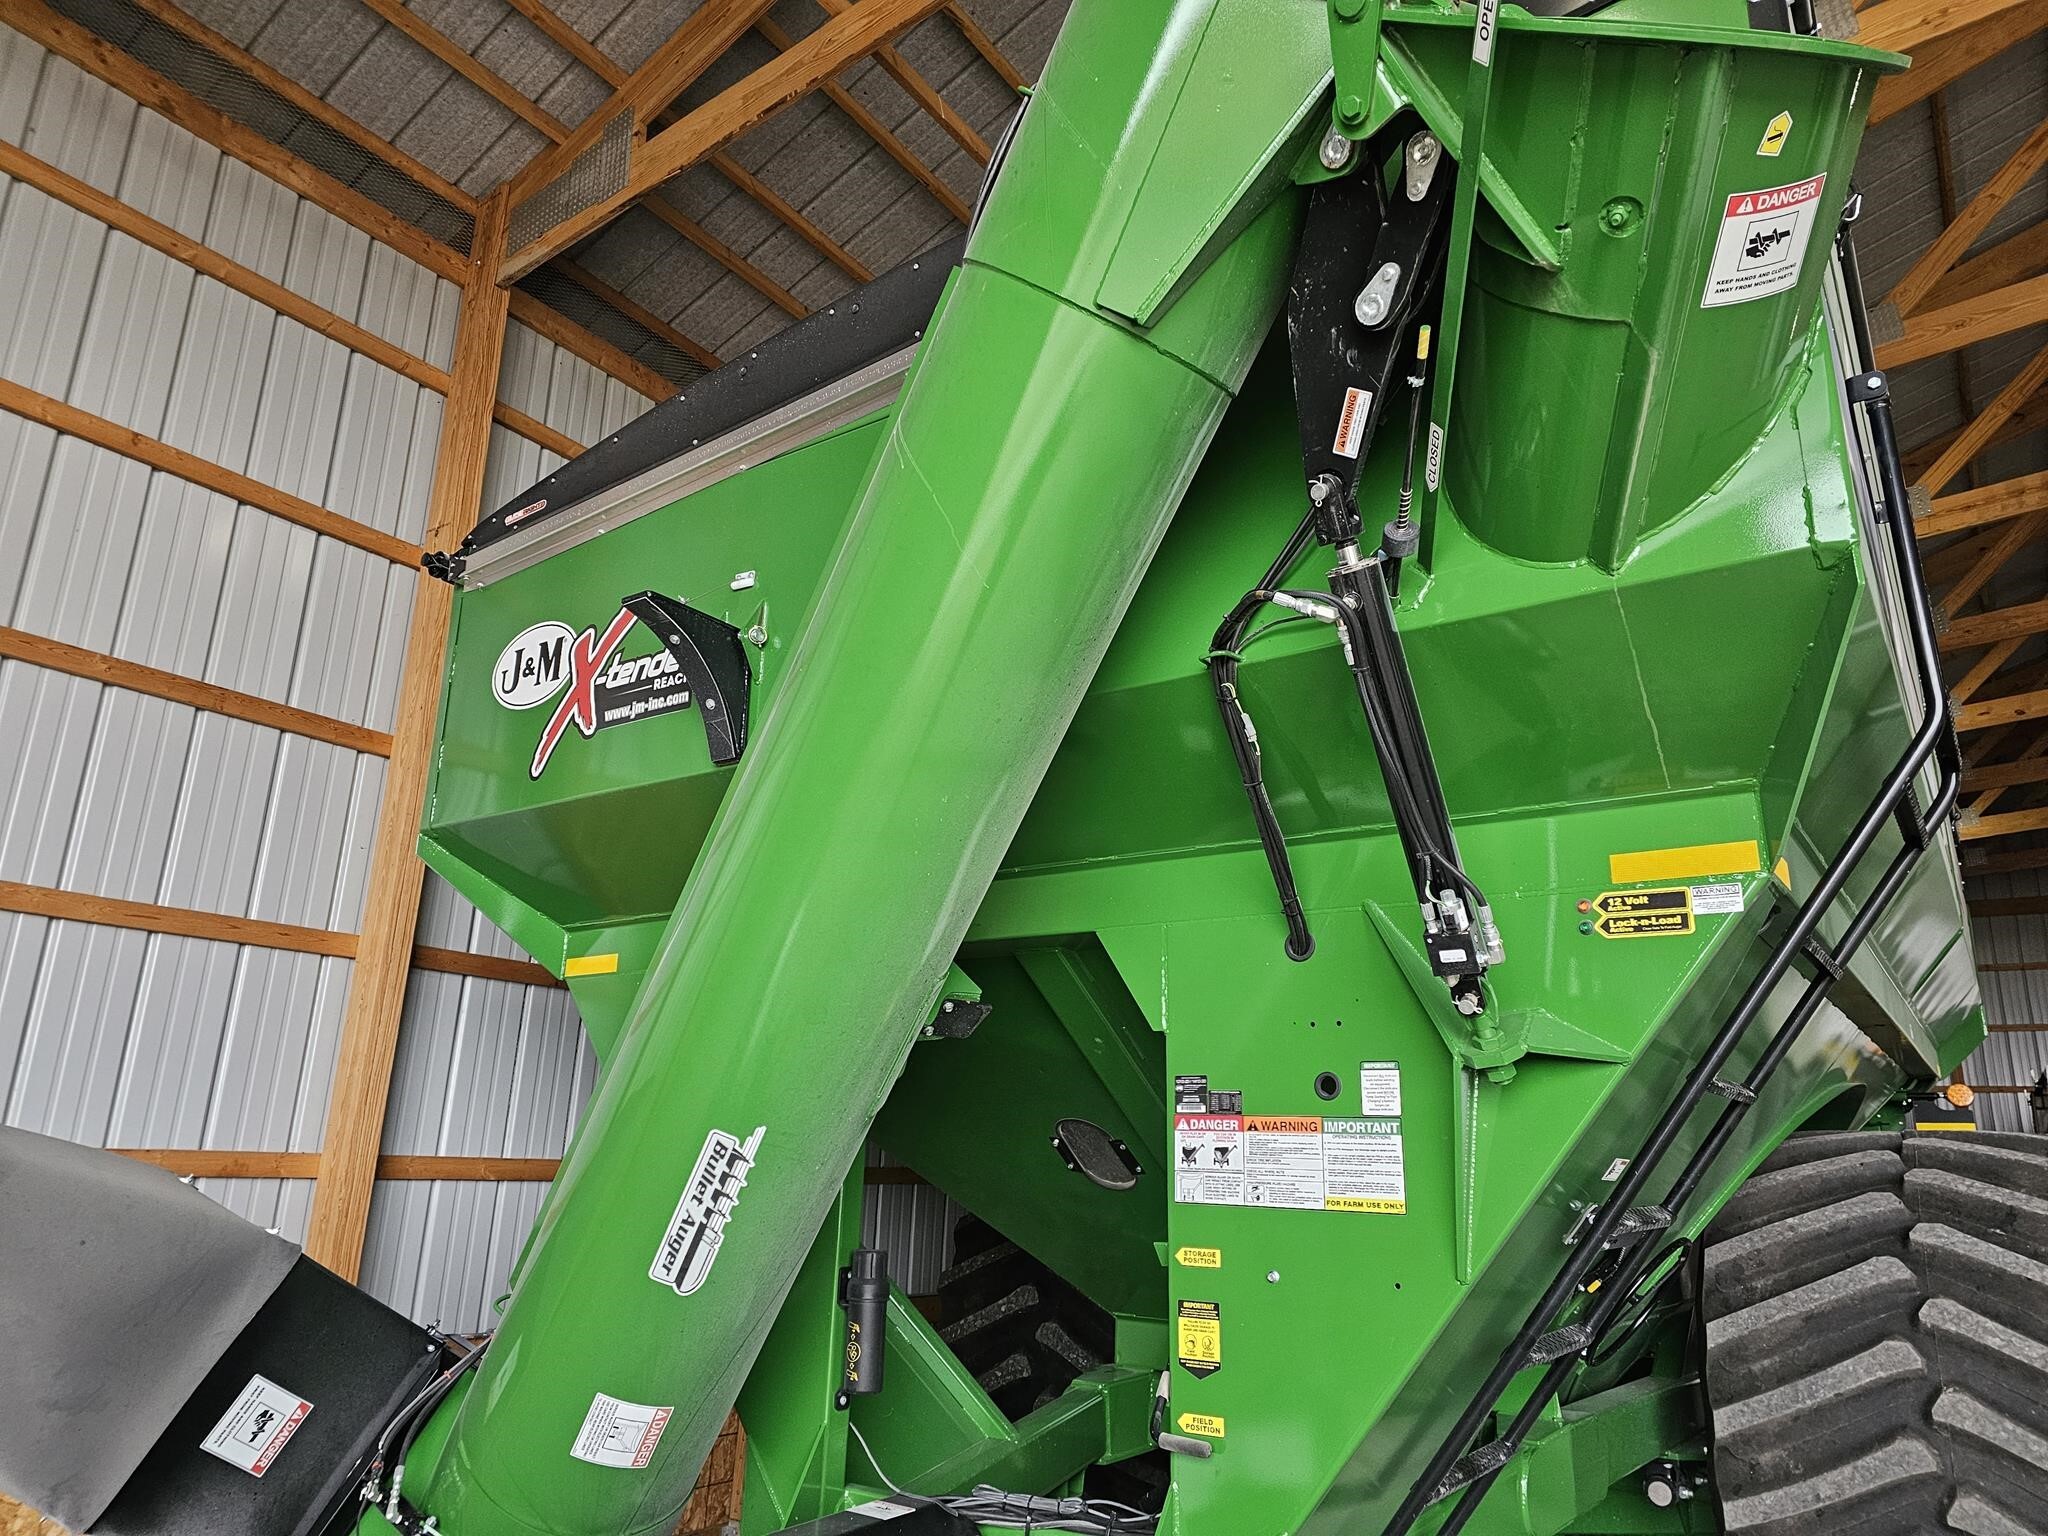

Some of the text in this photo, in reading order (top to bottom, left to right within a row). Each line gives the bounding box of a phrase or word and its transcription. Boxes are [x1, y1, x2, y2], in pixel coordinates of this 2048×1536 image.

[1480, 0, 1494, 41] OPE
[1757, 182, 1816, 210] DANGER
[1735, 275, 1757, 283] HANDS
[1771, 262, 1797, 275] CLOTHING
[1734, 283, 1752, 291] FROM
[1754, 278, 1776, 287] MOVING
[1340, 394, 1357, 440] WARNING
[1428, 430, 1440, 484] CLOSED
[501, 635, 566, 695] J&M
[653, 673, 688, 691] REAC
[604, 690, 690, 722] www.jm-inc.com
[1695, 885, 1737, 894] WARNING
[1607, 896, 1649, 906] 12 Volt
[1609, 915, 1682, 928] Lock-n-Load
[1190, 1119, 1239, 1130] DANGER
[1260, 1121, 1318, 1132] WARNING
[1324, 1121, 1400, 1133] IMPORTANT
[661, 1139, 729, 1277] Bullet Auger
[1183, 1302, 1215, 1310] IMPORTANT
[1185, 1424, 1221, 1434] POSITION
[1193, 1417, 1214, 1426] FIELD
[258, 1421, 296, 1468] DANGER
[634, 1422, 663, 1466] DANGER
